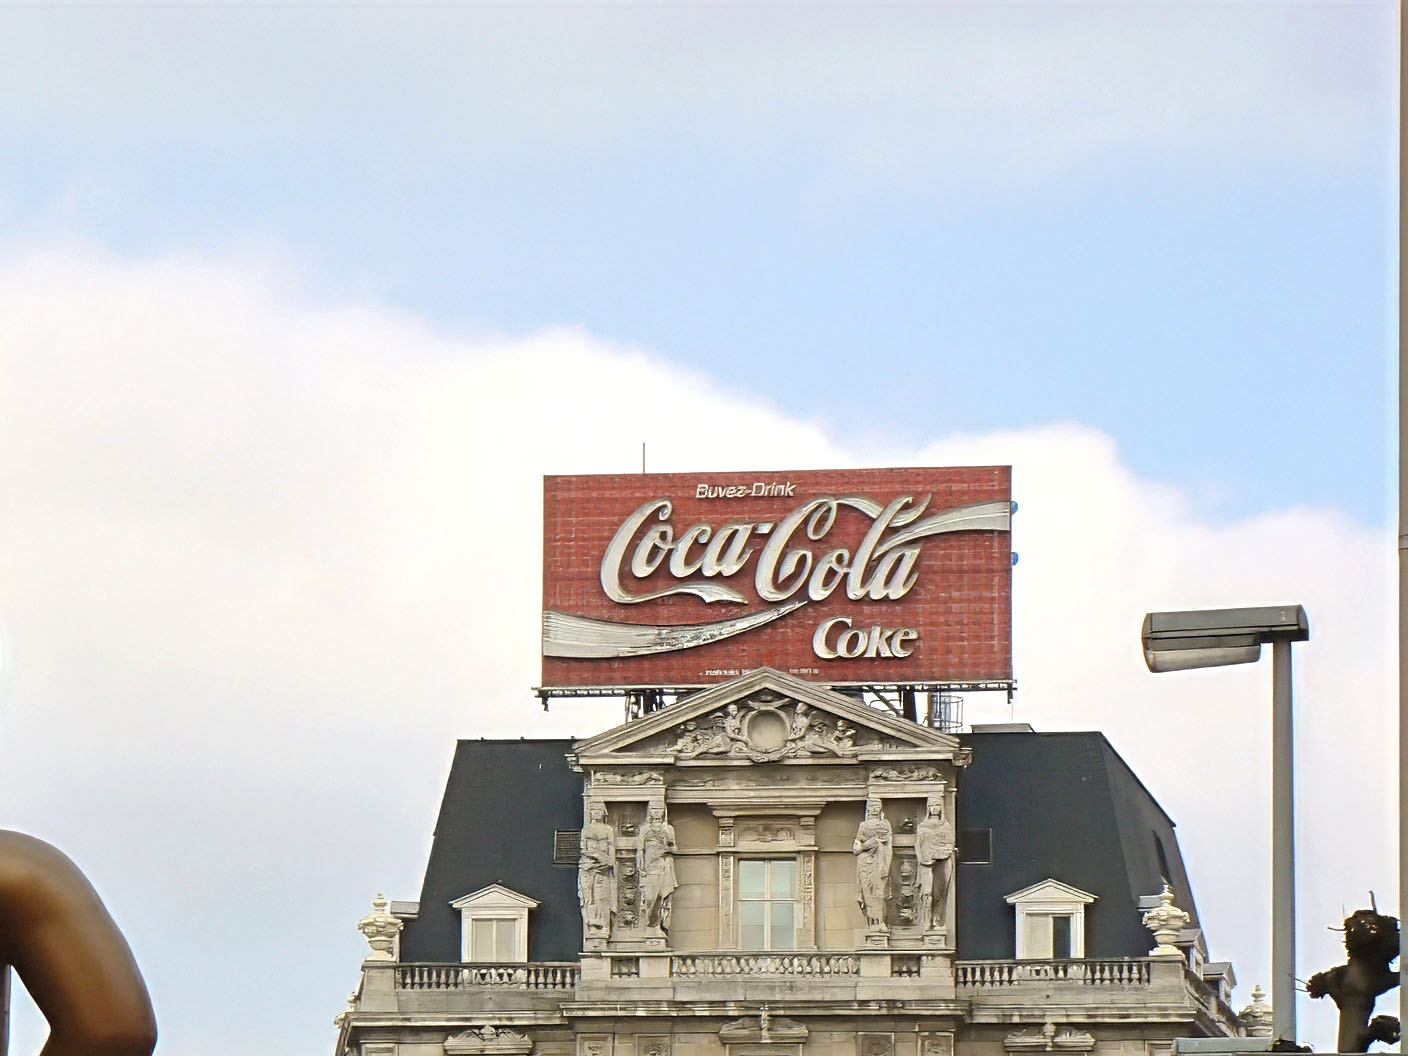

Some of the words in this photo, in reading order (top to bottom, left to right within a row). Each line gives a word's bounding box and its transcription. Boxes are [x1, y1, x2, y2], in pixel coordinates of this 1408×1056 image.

[695, 481, 797, 498] Buvez-Drink
[599, 492, 930, 605] Coca-Cola
[811, 616, 920, 659] Coke
